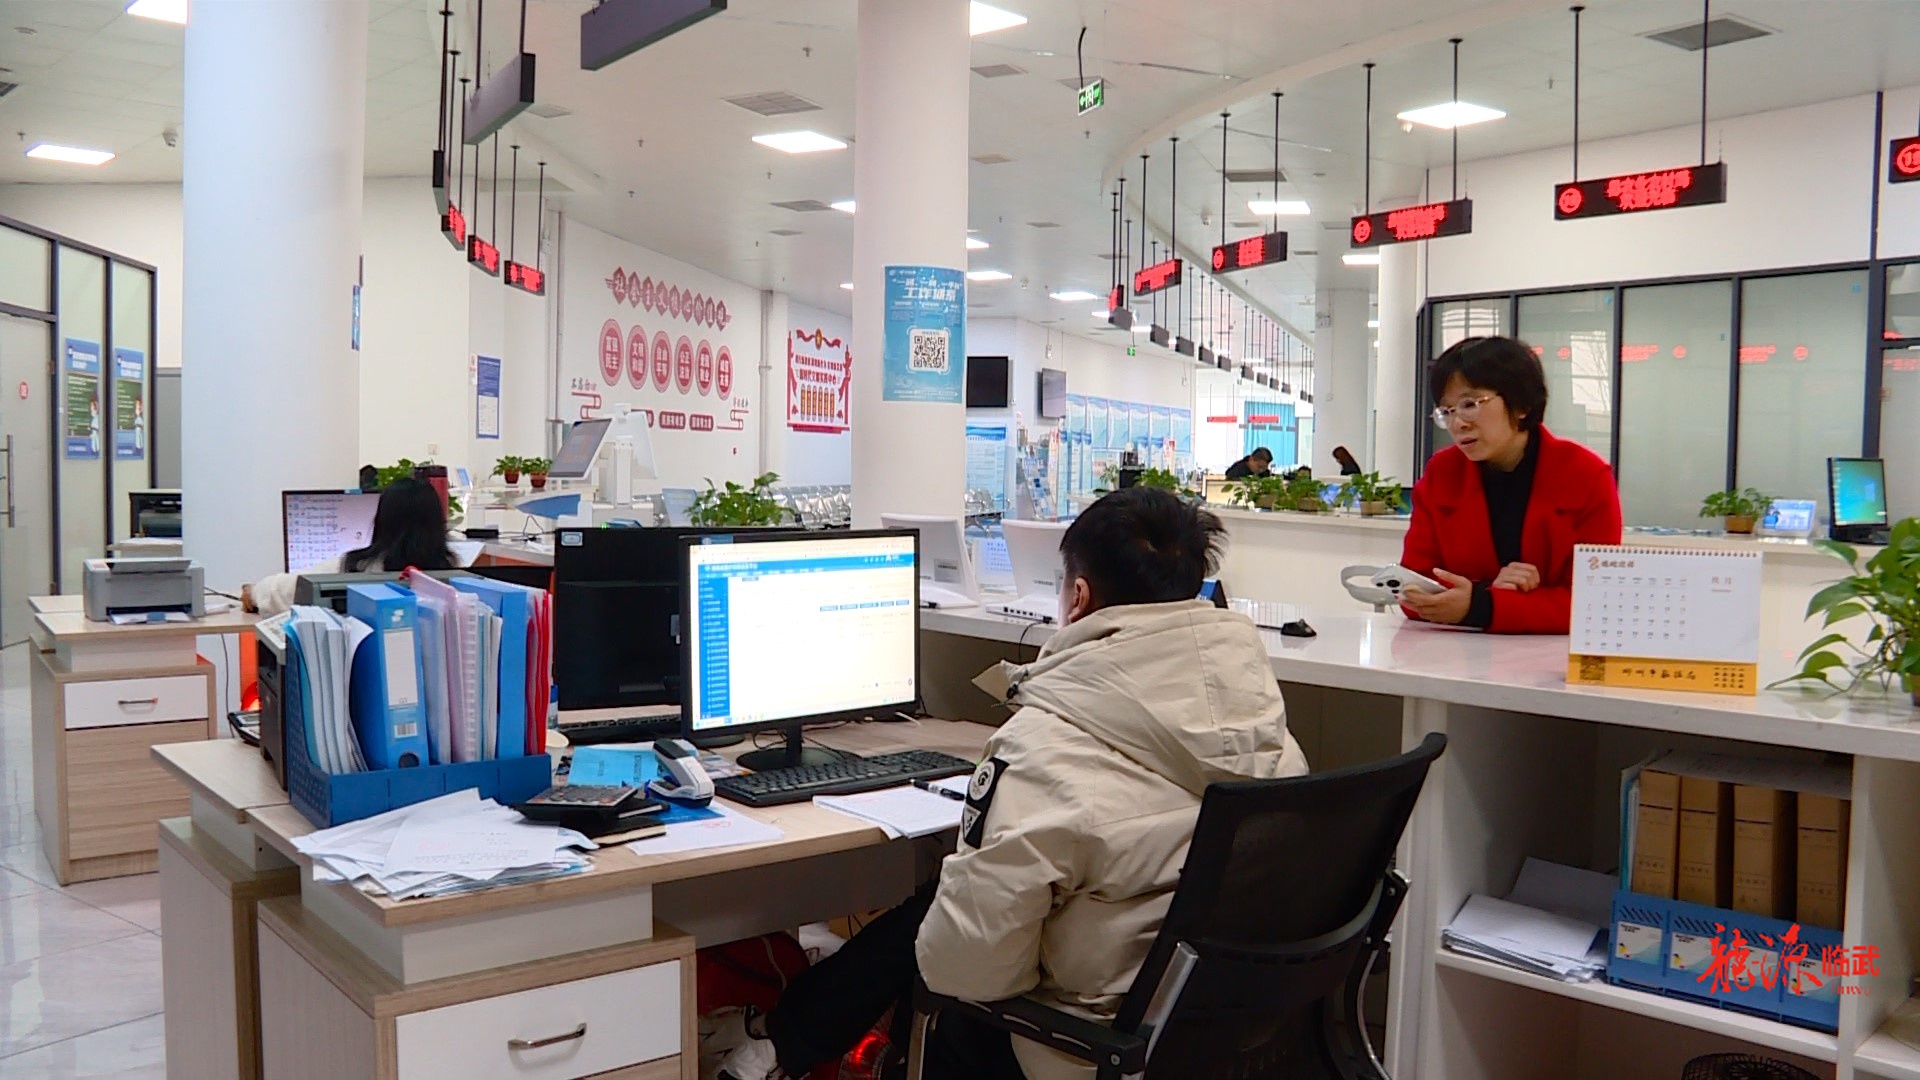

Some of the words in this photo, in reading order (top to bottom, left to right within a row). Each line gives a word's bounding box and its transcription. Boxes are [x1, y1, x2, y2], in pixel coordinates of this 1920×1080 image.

[614, 273, 727, 327] 社会主义核心价值观
